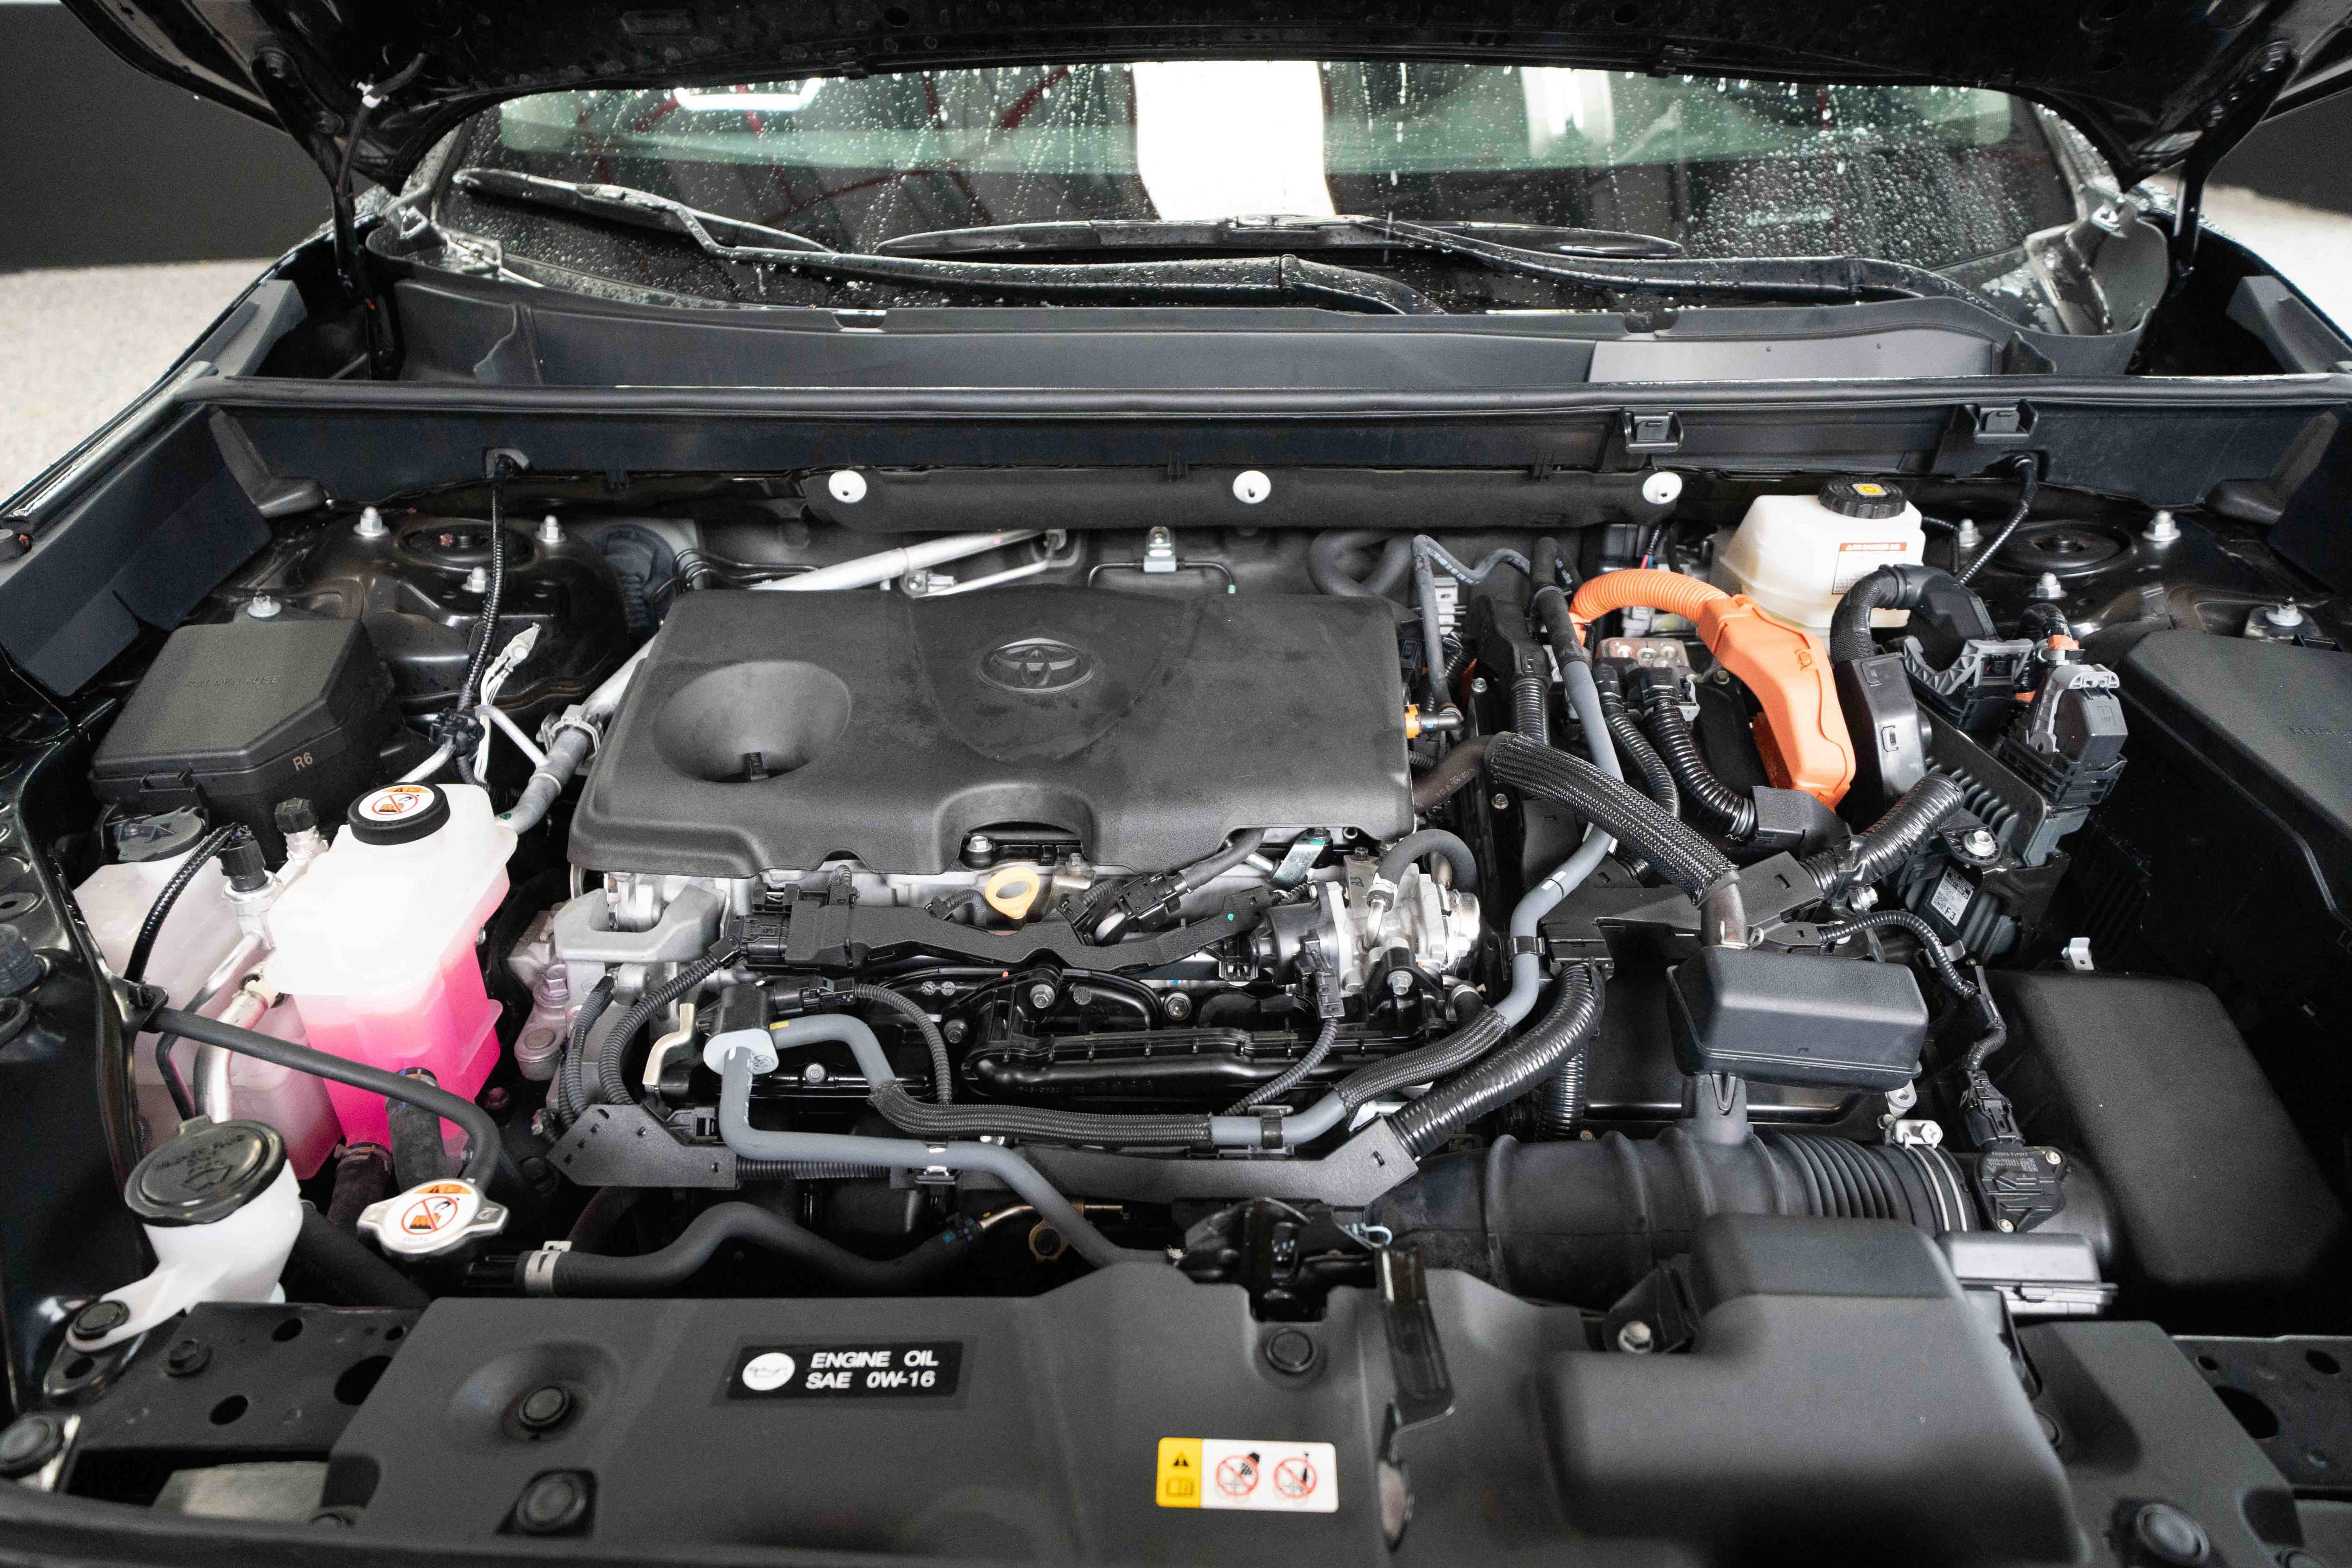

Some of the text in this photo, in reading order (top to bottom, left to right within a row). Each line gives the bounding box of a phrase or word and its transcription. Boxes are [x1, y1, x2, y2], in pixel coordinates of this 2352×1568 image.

[293, 752, 313, 771] R6
[810, 1350, 939, 1368] ENGINE OIL
[805, 1370, 936, 1389] SAE 0W-16
